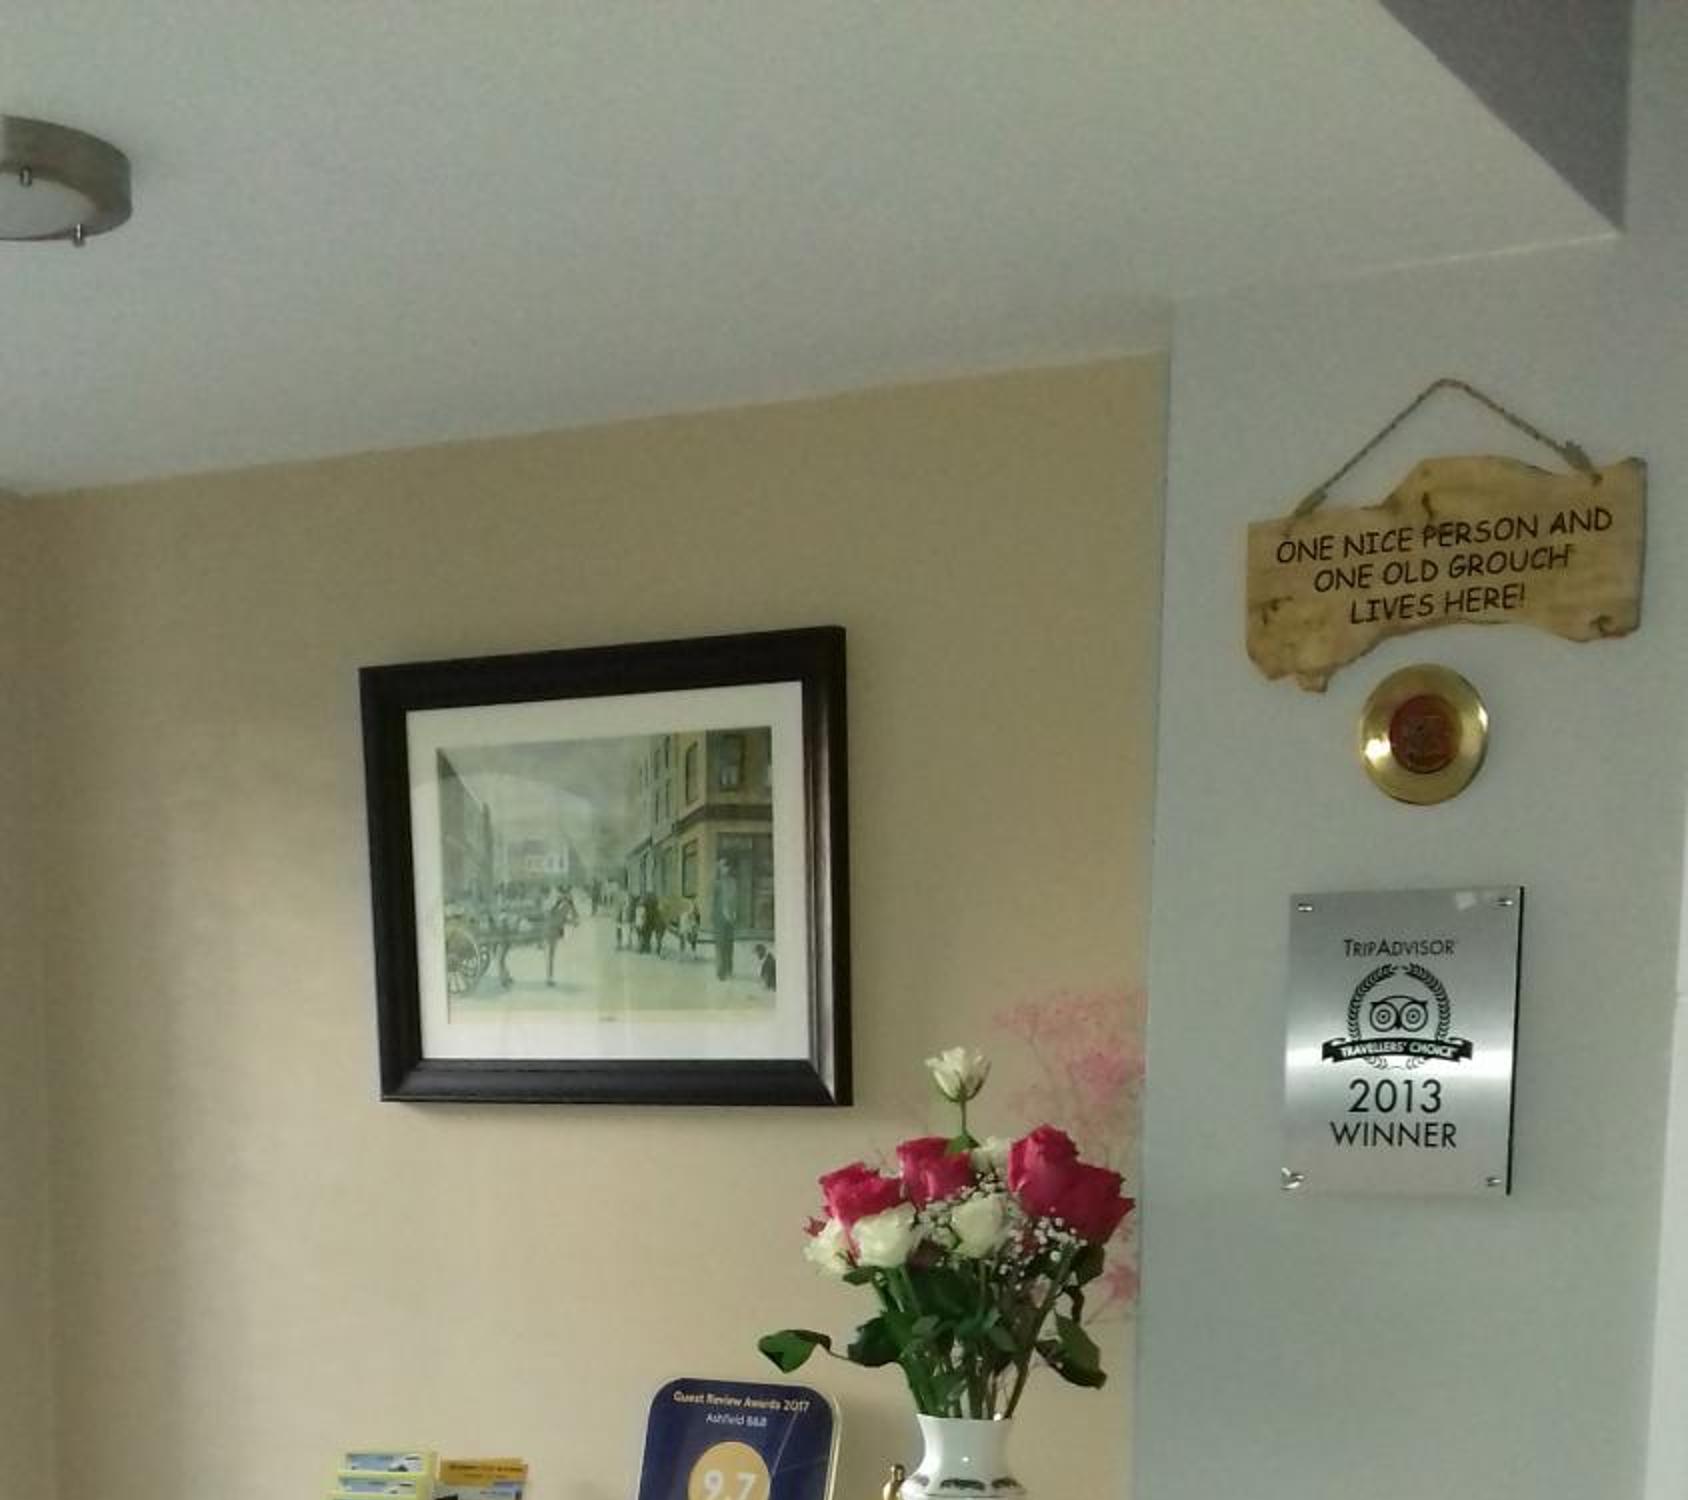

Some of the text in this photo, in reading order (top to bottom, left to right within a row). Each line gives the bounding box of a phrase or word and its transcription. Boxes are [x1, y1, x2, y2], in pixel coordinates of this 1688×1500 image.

[1276, 506, 1613, 563] ONE NICE PERSON AND
[1313, 546, 1570, 593] ONE OLD GROUCH
[1350, 583, 1526, 624] LIVES HERE!
[1346, 1078, 1442, 1114] 2013
[1329, 1122, 1458, 1148] WINNER
[673, 1390, 812, 1413] Guest Review Awards 2017
